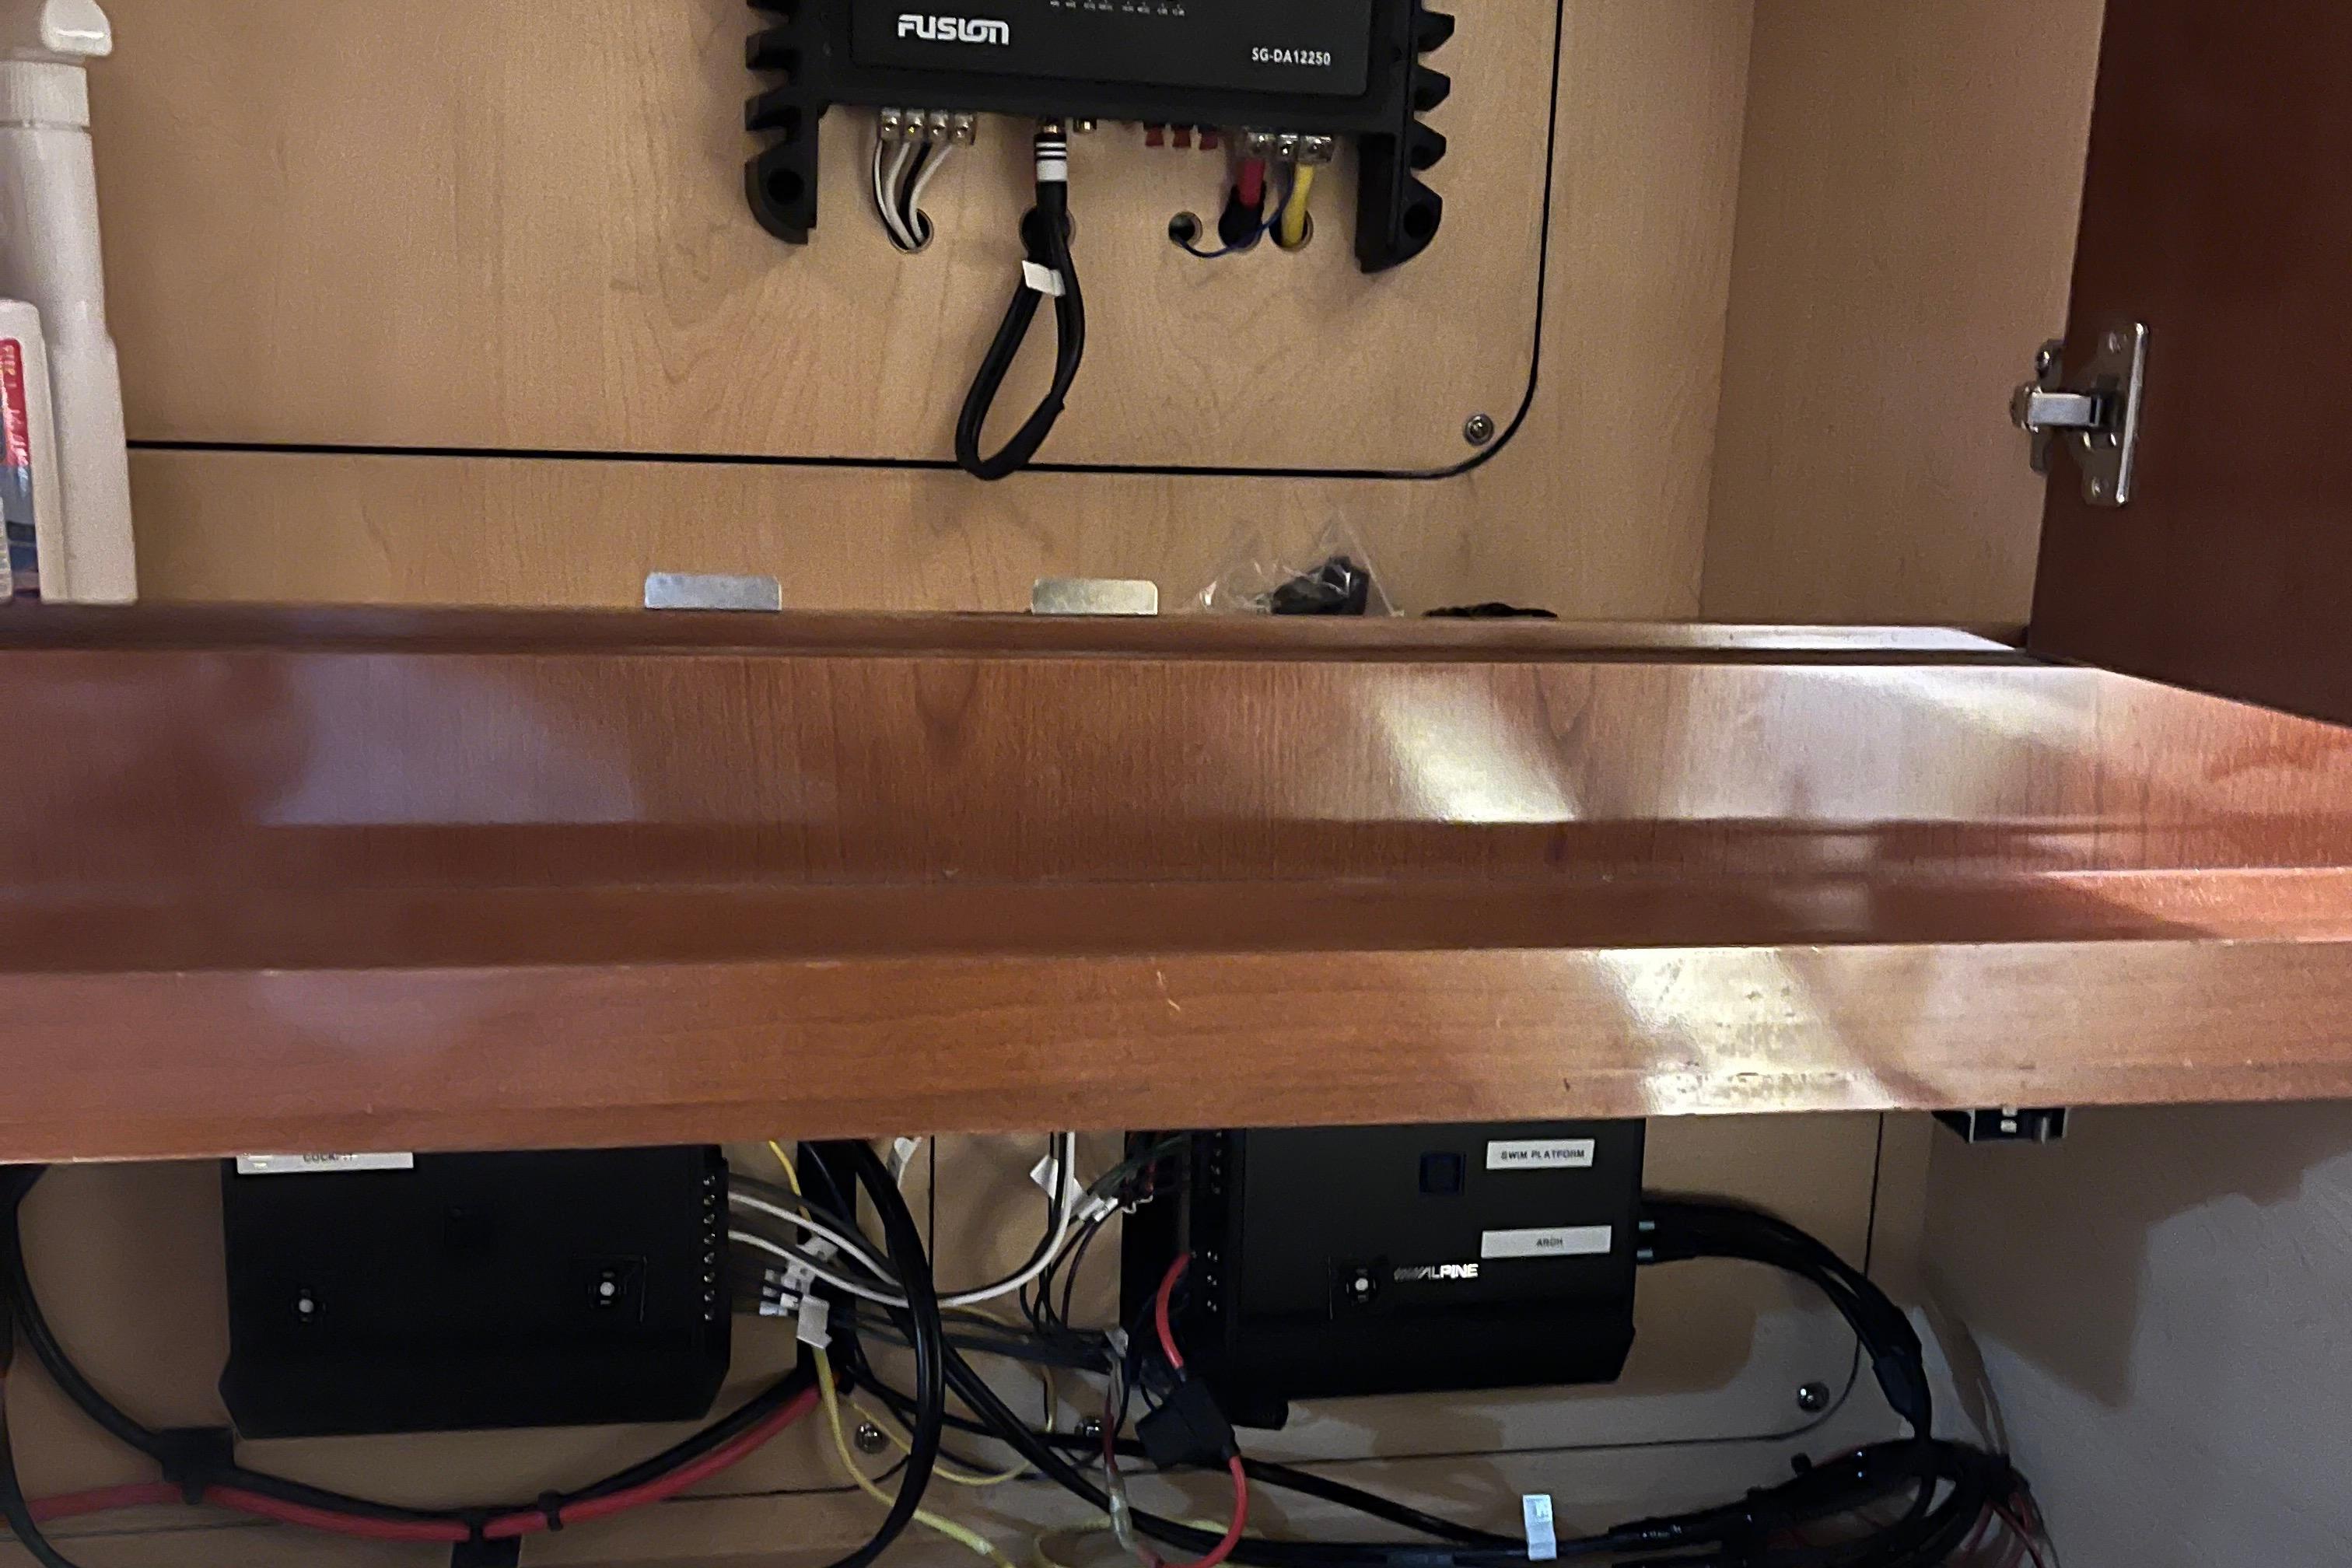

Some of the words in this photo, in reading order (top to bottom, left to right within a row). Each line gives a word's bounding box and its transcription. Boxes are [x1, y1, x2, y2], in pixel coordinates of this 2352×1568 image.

[1251, 47, 1331, 66] SG-DA12250
[1501, 1150, 1528, 1159] SWIM
[1531, 1149, 1584, 1158] PLATFORM
[1418, 1263, 1479, 1279] ALPINE
